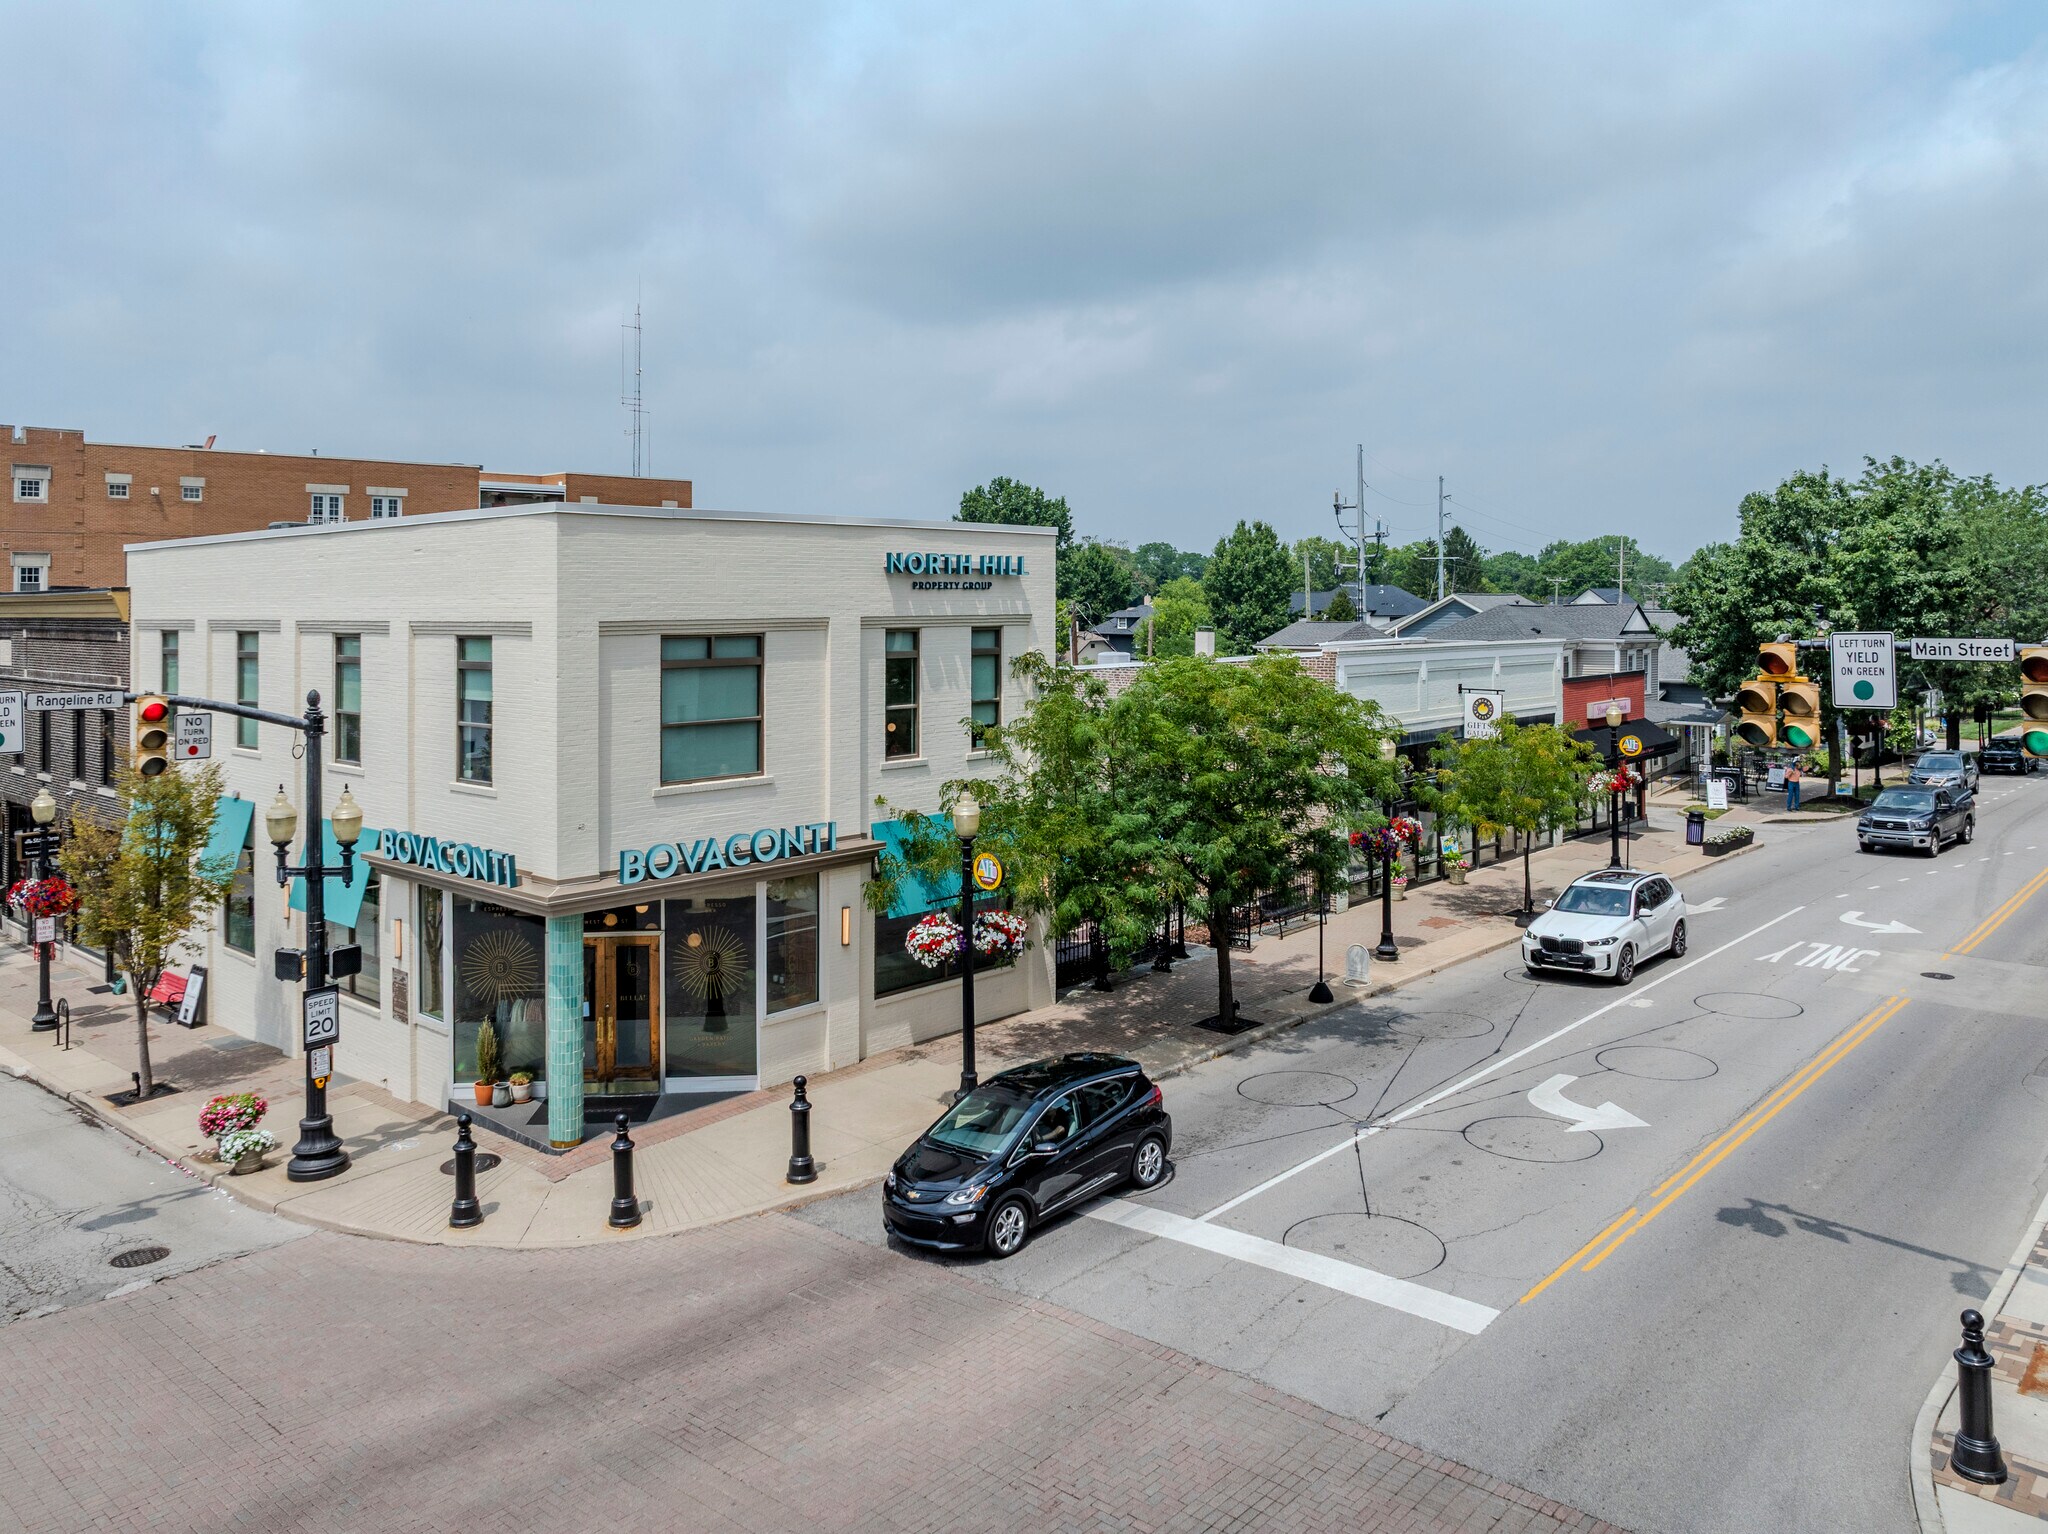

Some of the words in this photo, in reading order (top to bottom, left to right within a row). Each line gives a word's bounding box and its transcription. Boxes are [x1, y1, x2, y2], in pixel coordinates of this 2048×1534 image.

[886, 552, 972, 575] NORTH
[980, 555, 1029, 576] HILL
[912, 581, 960, 590] PROPERTY
[963, 581, 992, 590] GROUP
[1839, 639, 1858, 648] LEFT
[1862, 639, 1885, 648] TURN
[1915, 642, 1952, 656] Main
[1958, 642, 2010, 657] Street
[1846, 652, 1879, 663] YIELD
[1841, 667, 1853, 676] ON
[1856, 667, 1885, 676] GREEN
[0, 696, 16, 704] URN
[36, 694, 94, 708] Rangeline
[97, 694, 115, 704] Rd.
[0, 719, 15, 727] EEN
[185, 718, 202, 727] NO
[1467, 721, 1491, 730] GIFTS
[193, 737, 209, 745] RED
[382, 828, 516, 888] BOVACONTI
[619, 821, 837, 885] BOVACONTI
[1754, 941, 1881, 972] ONLY
[308, 998, 334, 1009] SPEED
[311, 1007, 332, 1018] LIMIT
[309, 1017, 333, 1037] 20
